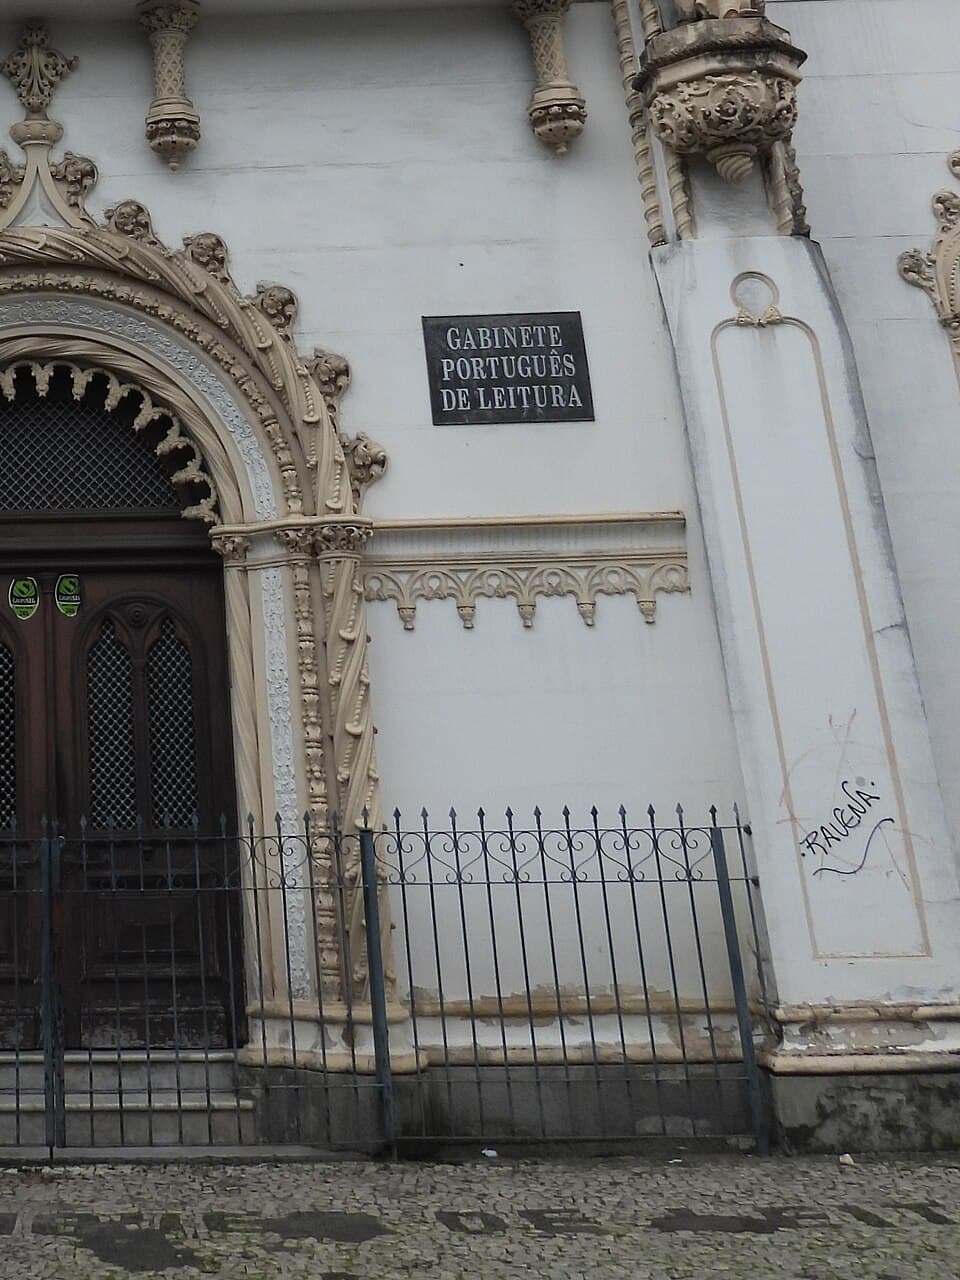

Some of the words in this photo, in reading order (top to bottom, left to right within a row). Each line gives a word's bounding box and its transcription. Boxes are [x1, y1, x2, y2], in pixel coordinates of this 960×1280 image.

[446, 325, 563, 351] GABINETE
[441, 349, 576, 381] PORTUGUÊS
[440, 388, 471, 411] DE
[477, 384, 583, 410] LEITURA
